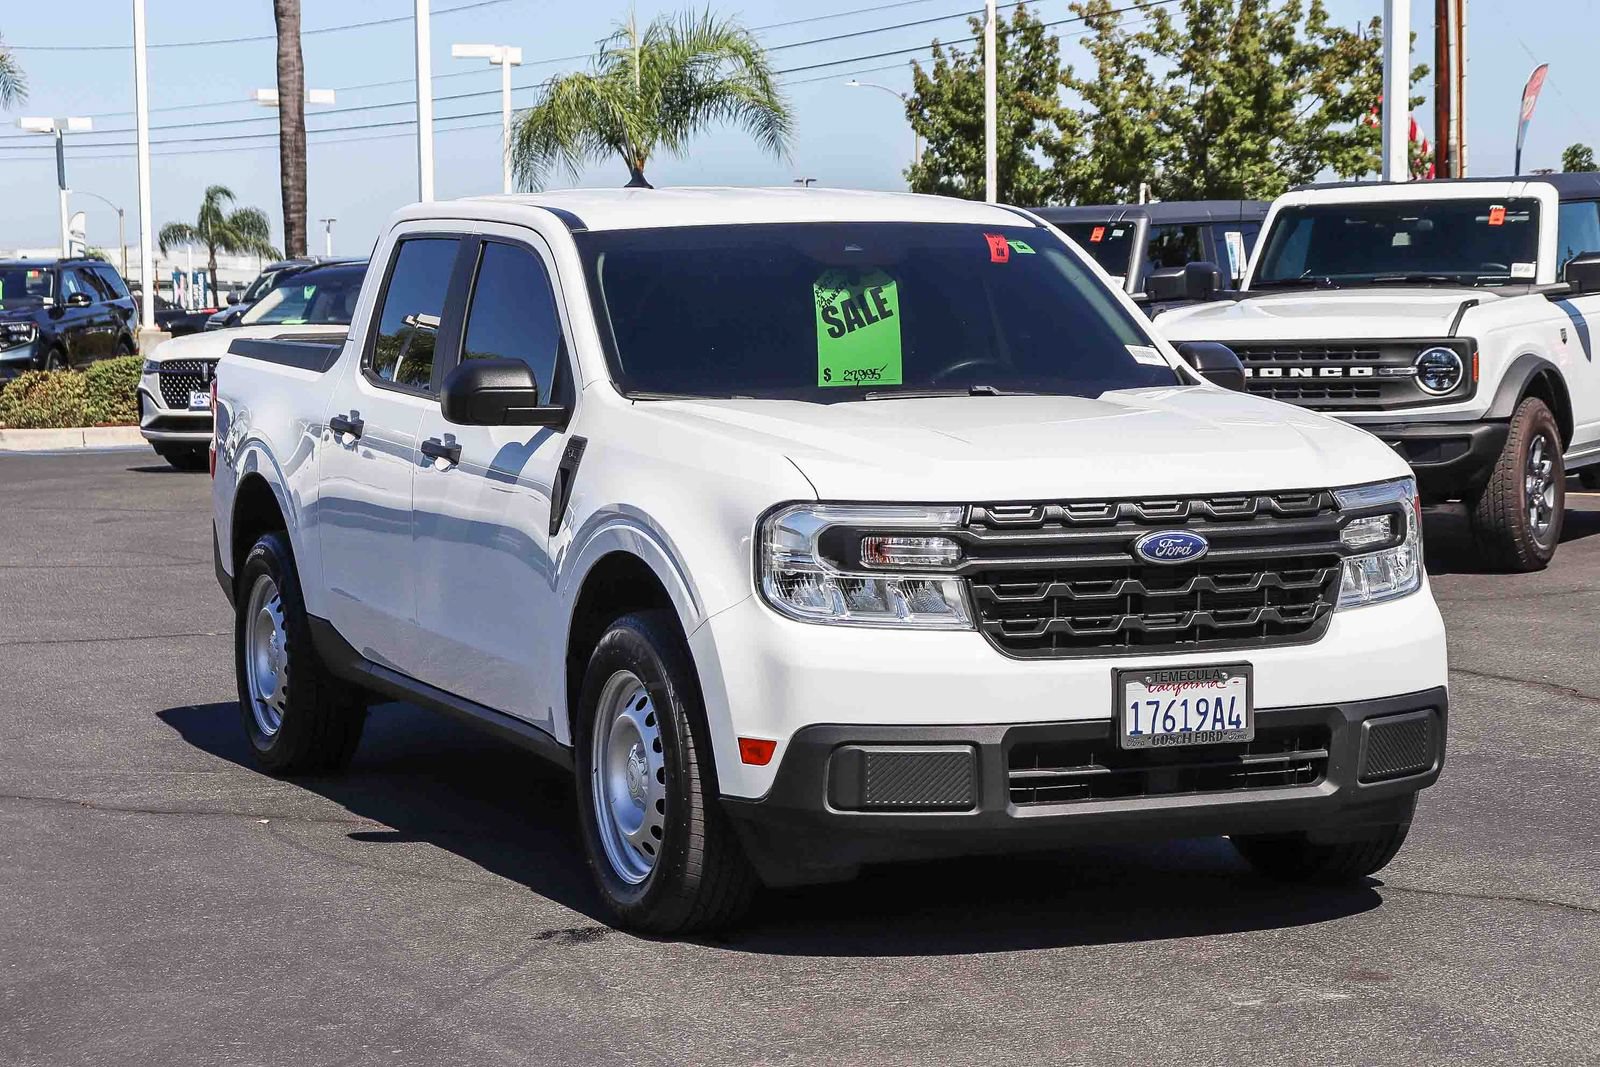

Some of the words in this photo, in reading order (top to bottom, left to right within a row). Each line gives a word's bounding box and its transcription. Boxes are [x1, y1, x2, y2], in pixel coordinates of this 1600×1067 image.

[821, 286, 894, 339] SALE
[1244, 367, 1373, 378] ONCO
[1155, 538, 1193, 557] Ford
[1152, 669, 1221, 683] TEMECULA
[1129, 695, 1243, 735] 17619A4
[1195, 730, 1223, 743] FORD
